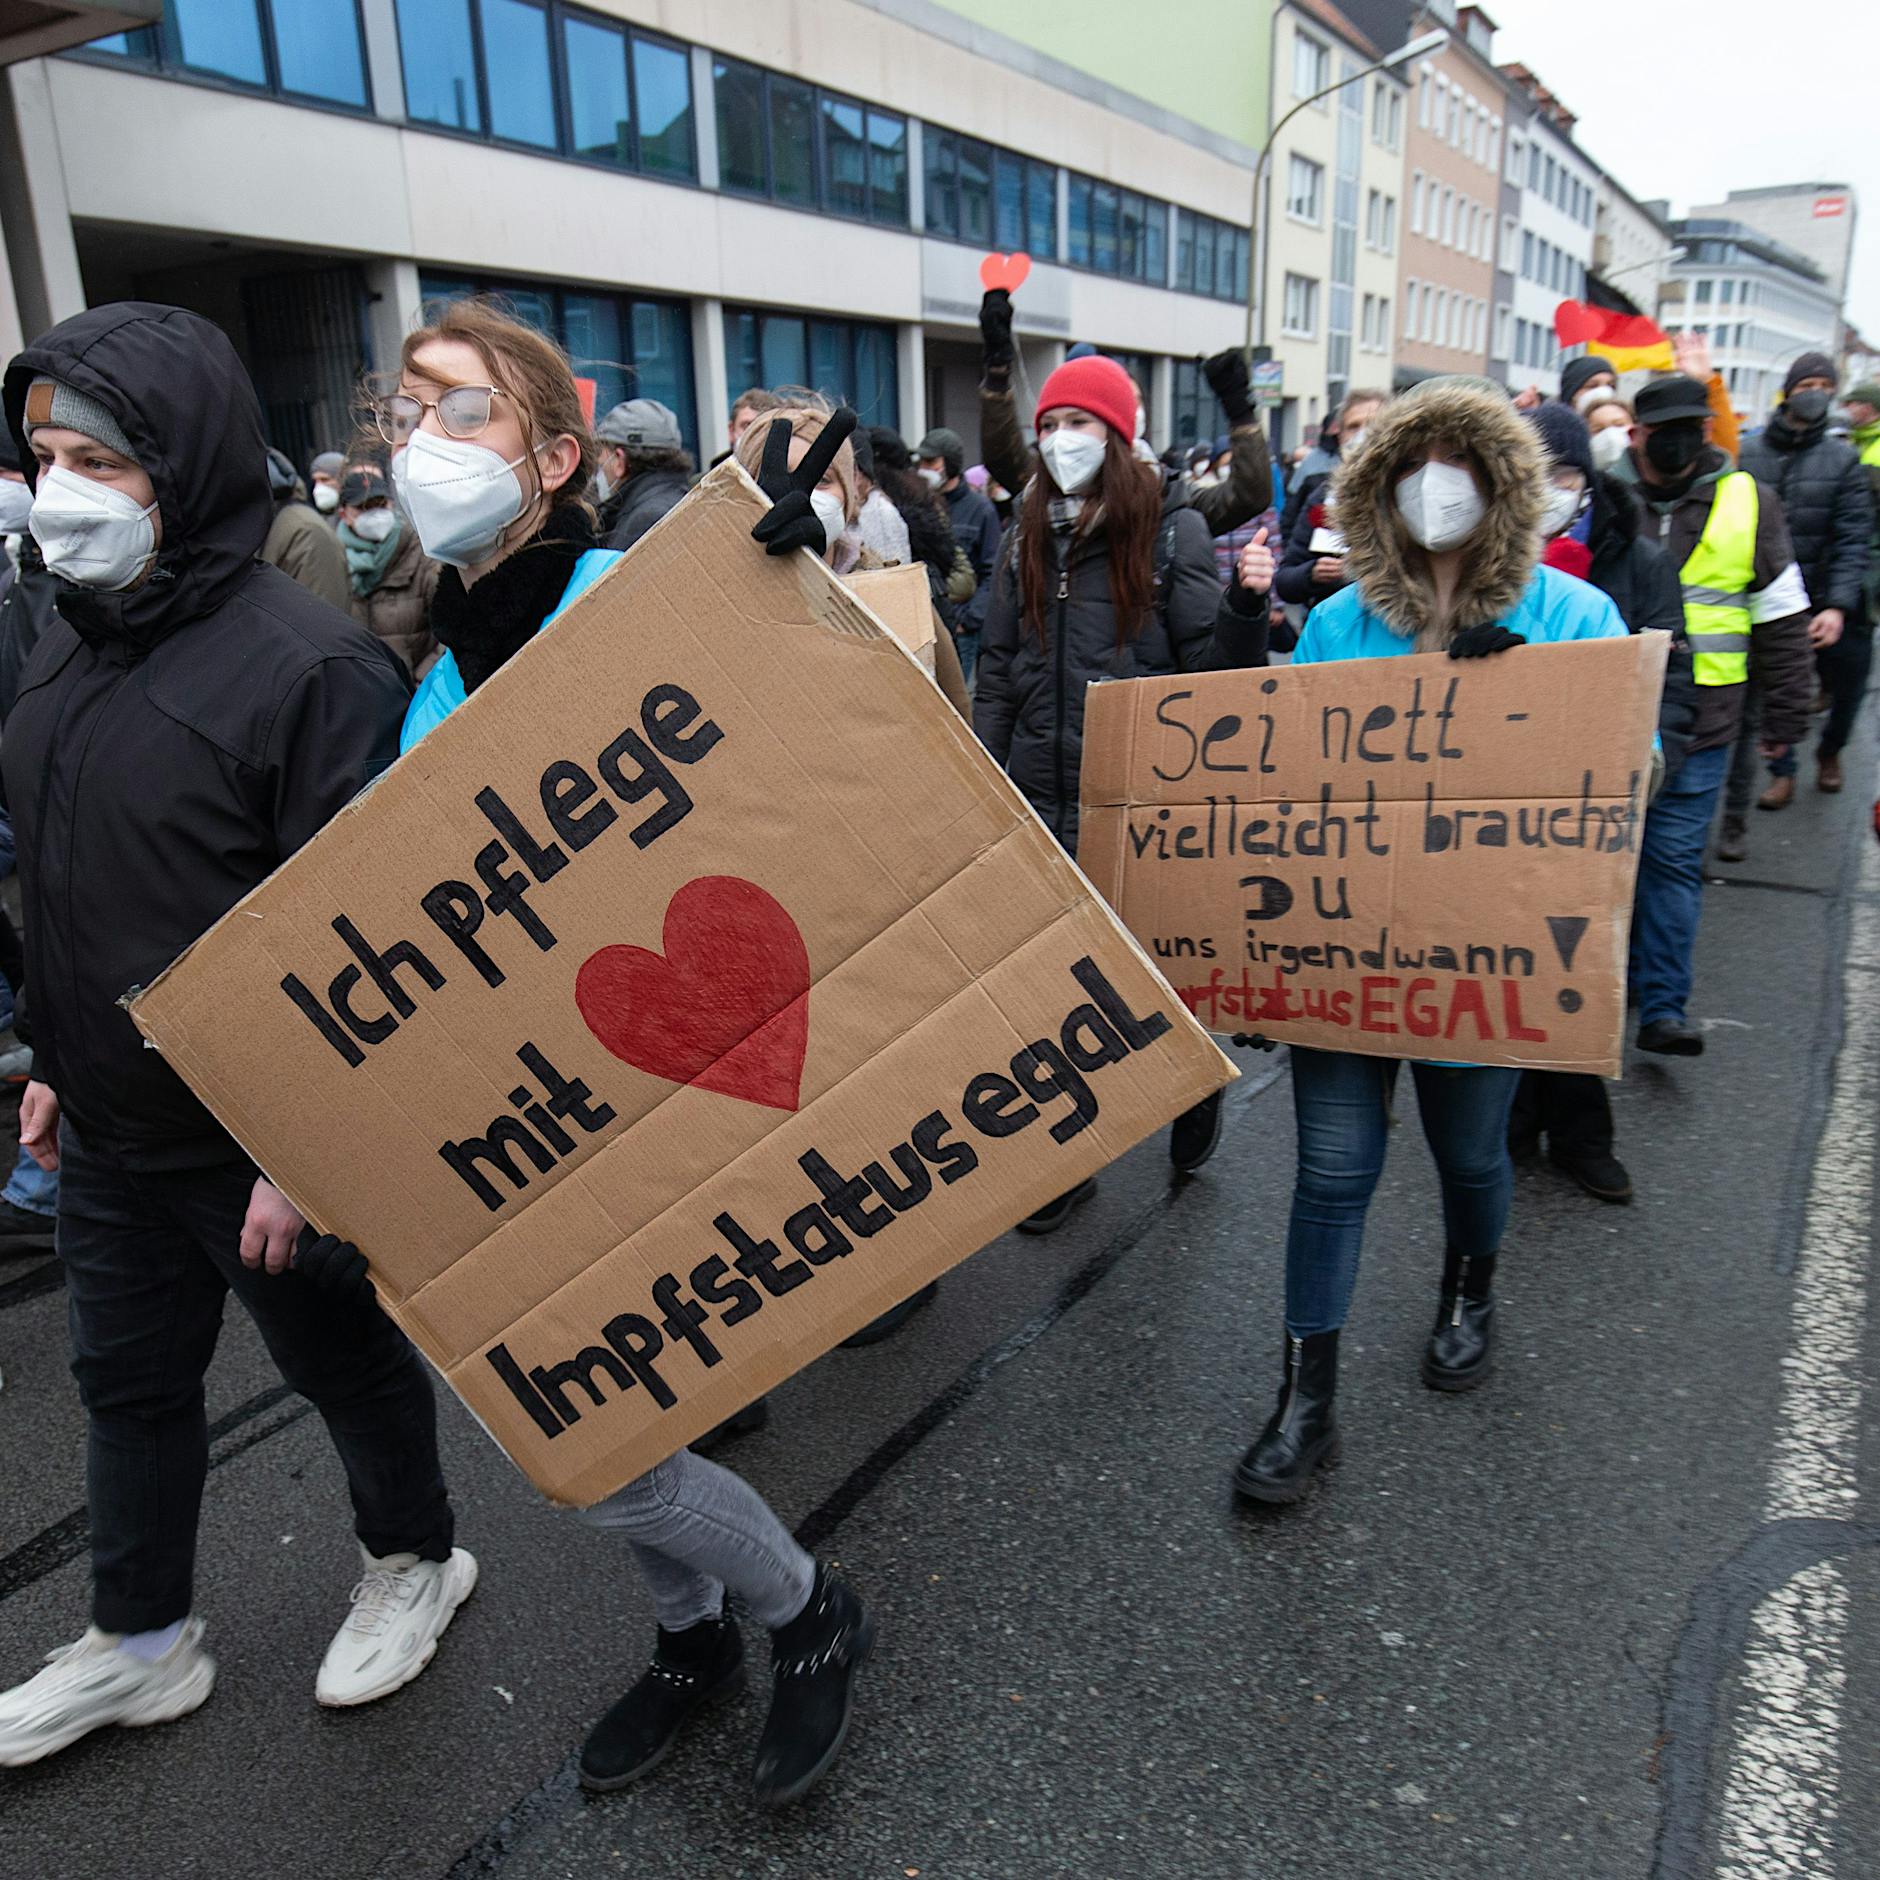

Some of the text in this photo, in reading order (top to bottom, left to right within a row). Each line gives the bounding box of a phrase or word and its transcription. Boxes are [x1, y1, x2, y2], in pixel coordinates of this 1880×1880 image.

[1152, 679, 1278, 782] Sei
[1323, 677, 1463, 763] nett
[1128, 769, 1641, 860] vielleicht brauchst
[280, 913, 447, 1069] Ich
[1153, 936, 1218, 960] uns
[438, 1041, 618, 1213] mit
[485, 1147, 980, 1441] Impfstatus
